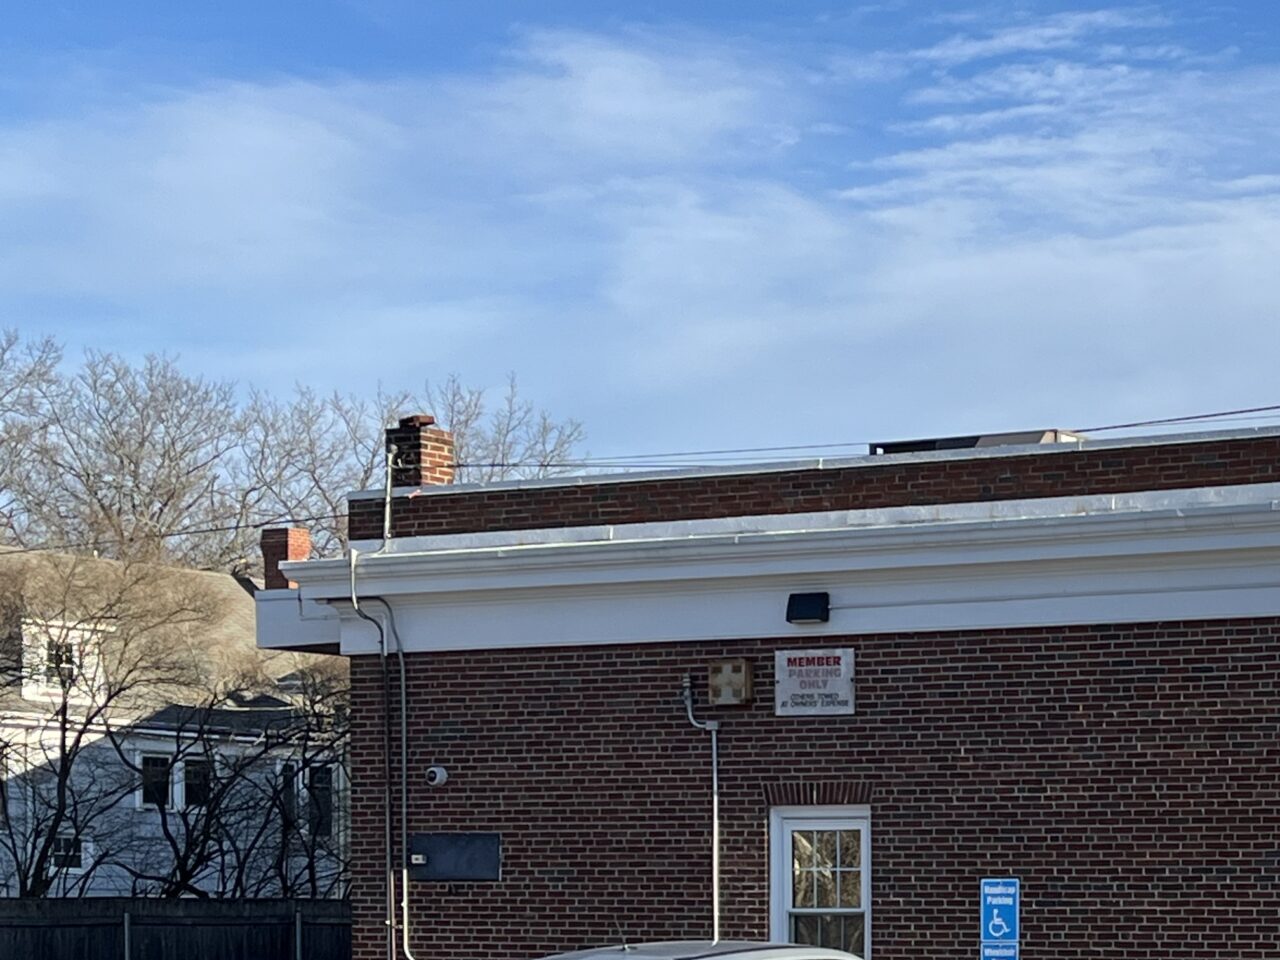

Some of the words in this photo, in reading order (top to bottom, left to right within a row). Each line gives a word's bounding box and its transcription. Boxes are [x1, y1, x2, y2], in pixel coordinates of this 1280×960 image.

[787, 656, 842, 667] MEMBER
[788, 668, 842, 679] PARKING
[799, 679, 829, 690] ONLY
